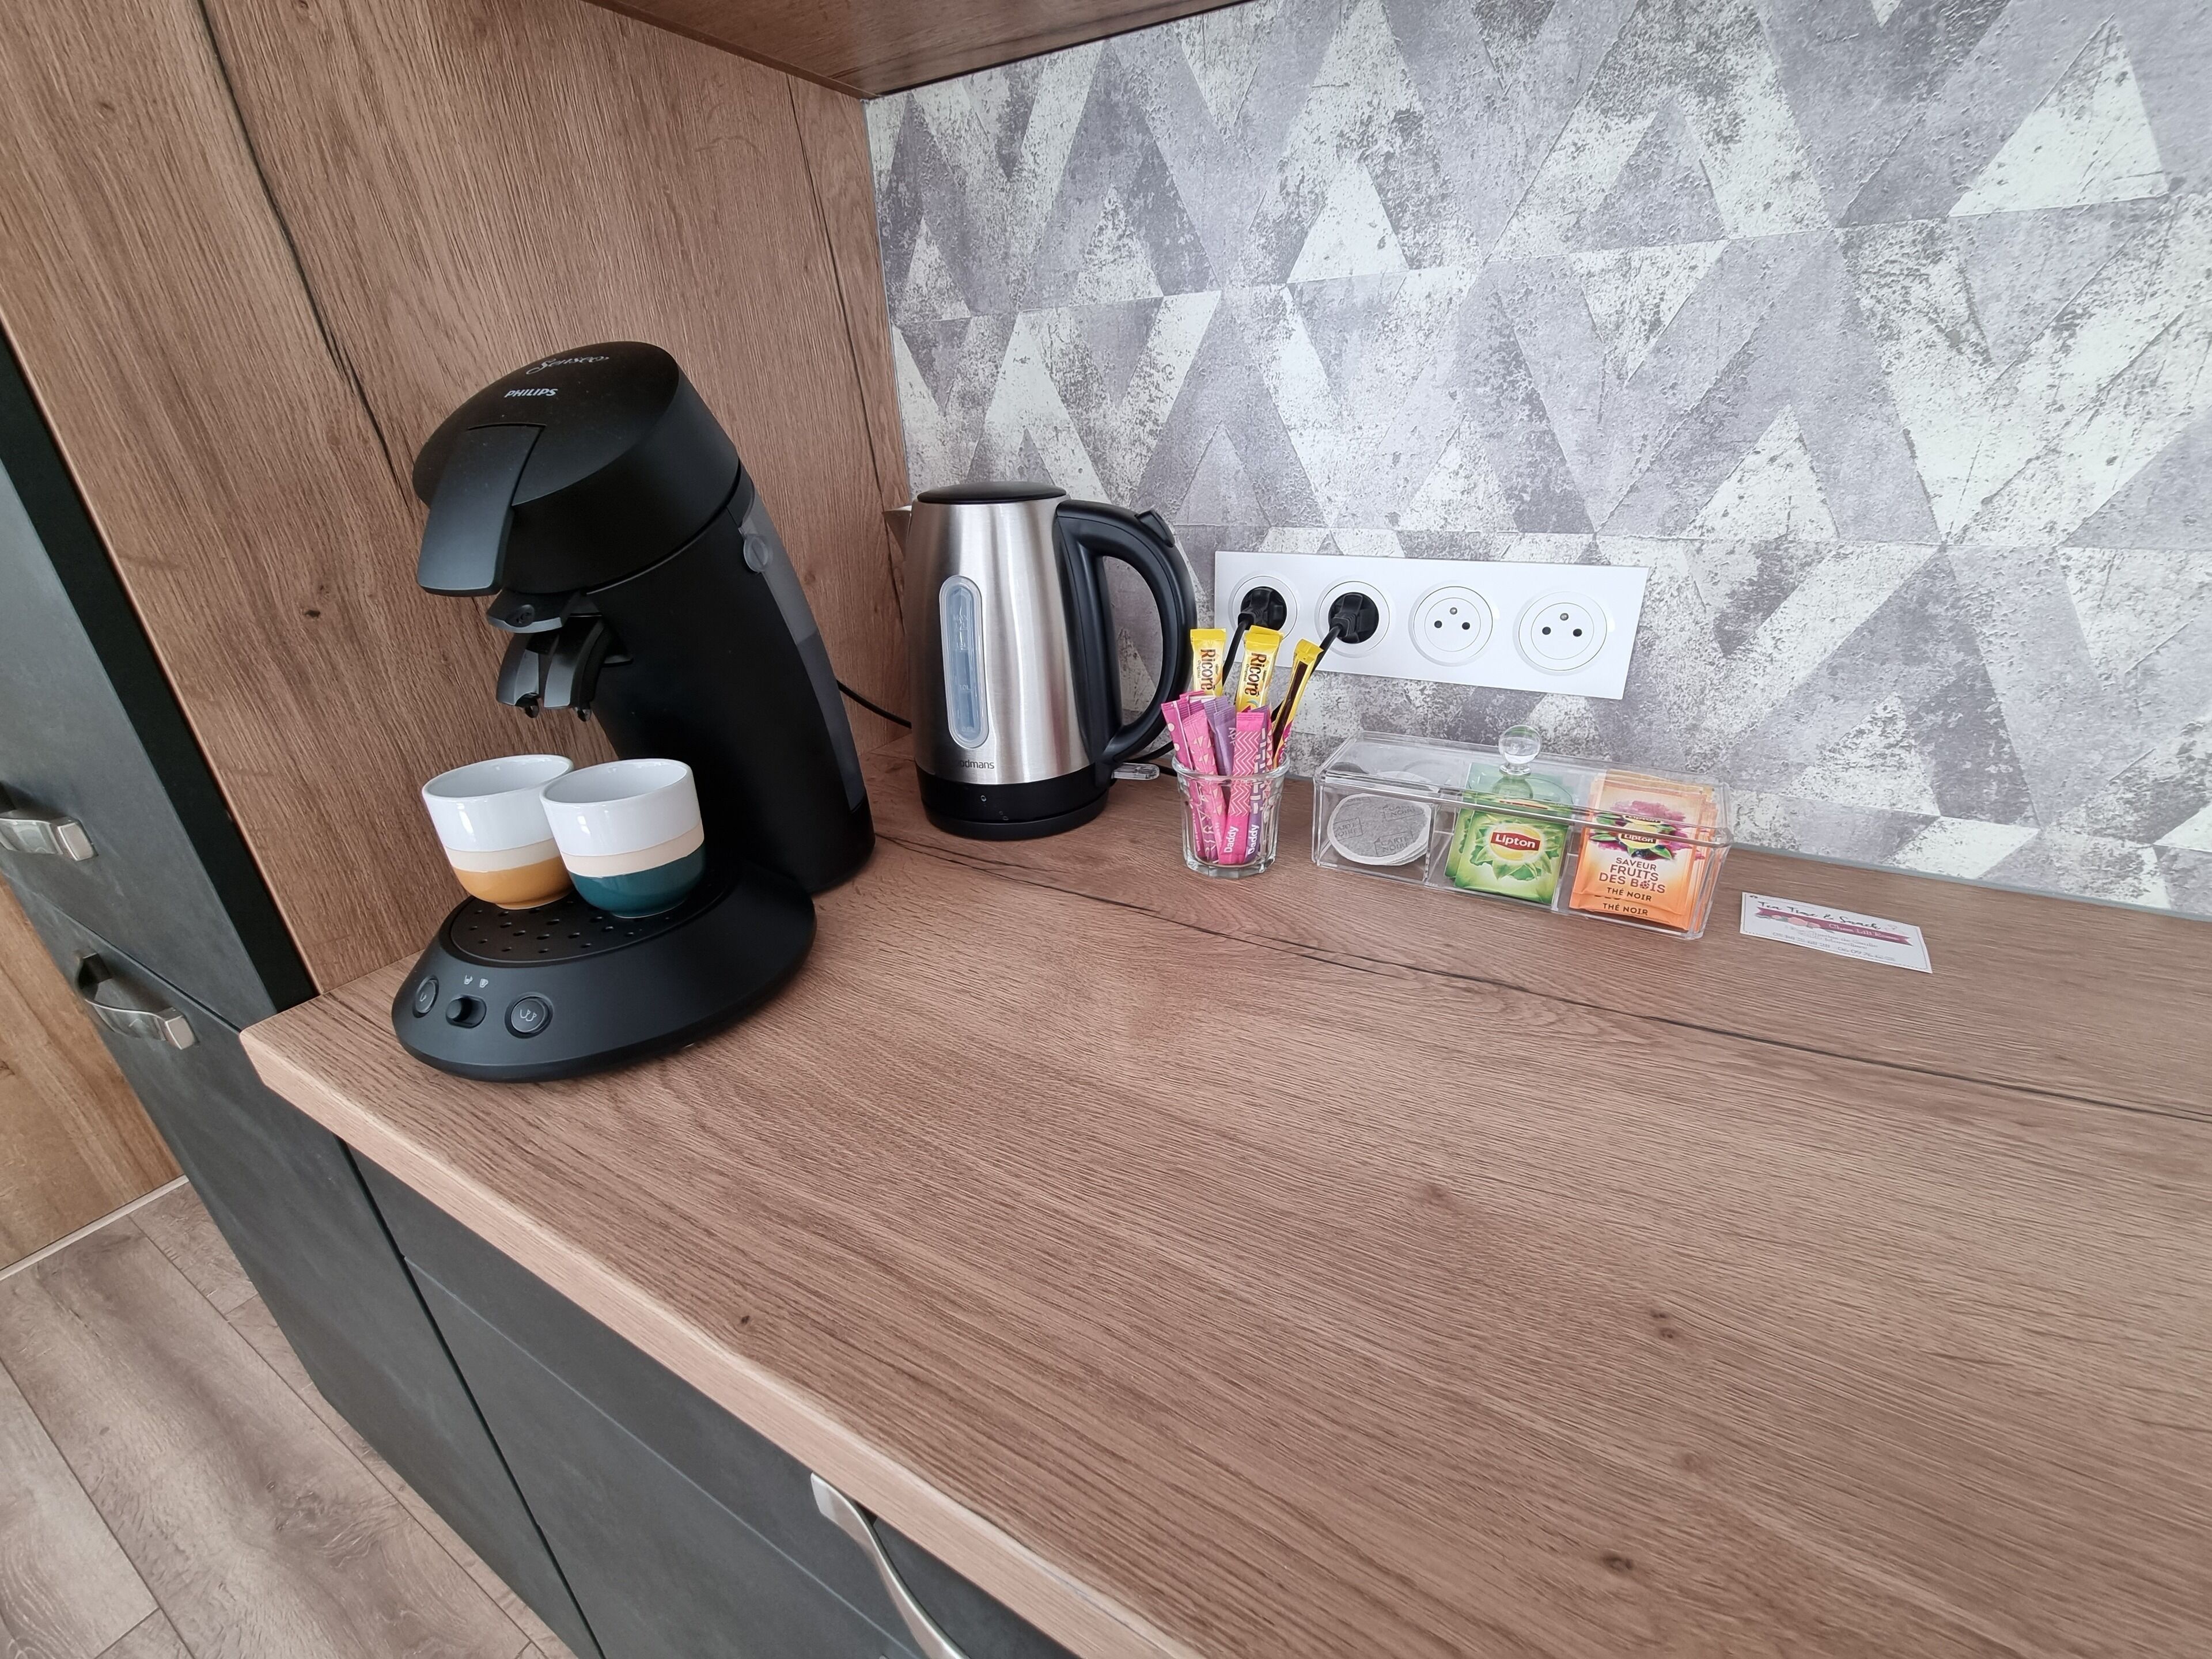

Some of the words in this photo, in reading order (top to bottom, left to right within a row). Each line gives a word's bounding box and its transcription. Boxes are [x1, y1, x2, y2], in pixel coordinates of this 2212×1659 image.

[504, 388, 558, 397] PHILIPS
[1224, 825, 1239, 853] Daddy
[1247, 824, 1260, 855] Daddy
[1495, 834, 1536, 849] Lipton
[1615, 857, 1657, 872] SAVEUR
[1599, 872, 1626, 885] DES
[1609, 864, 1659, 881] FRUITS
[1607, 887, 1624, 896] THÉ
[1627, 891, 1652, 902] NOIR
[1603, 903, 1620, 911] THÉ
[1623, 906, 1649, 916] NOIR
